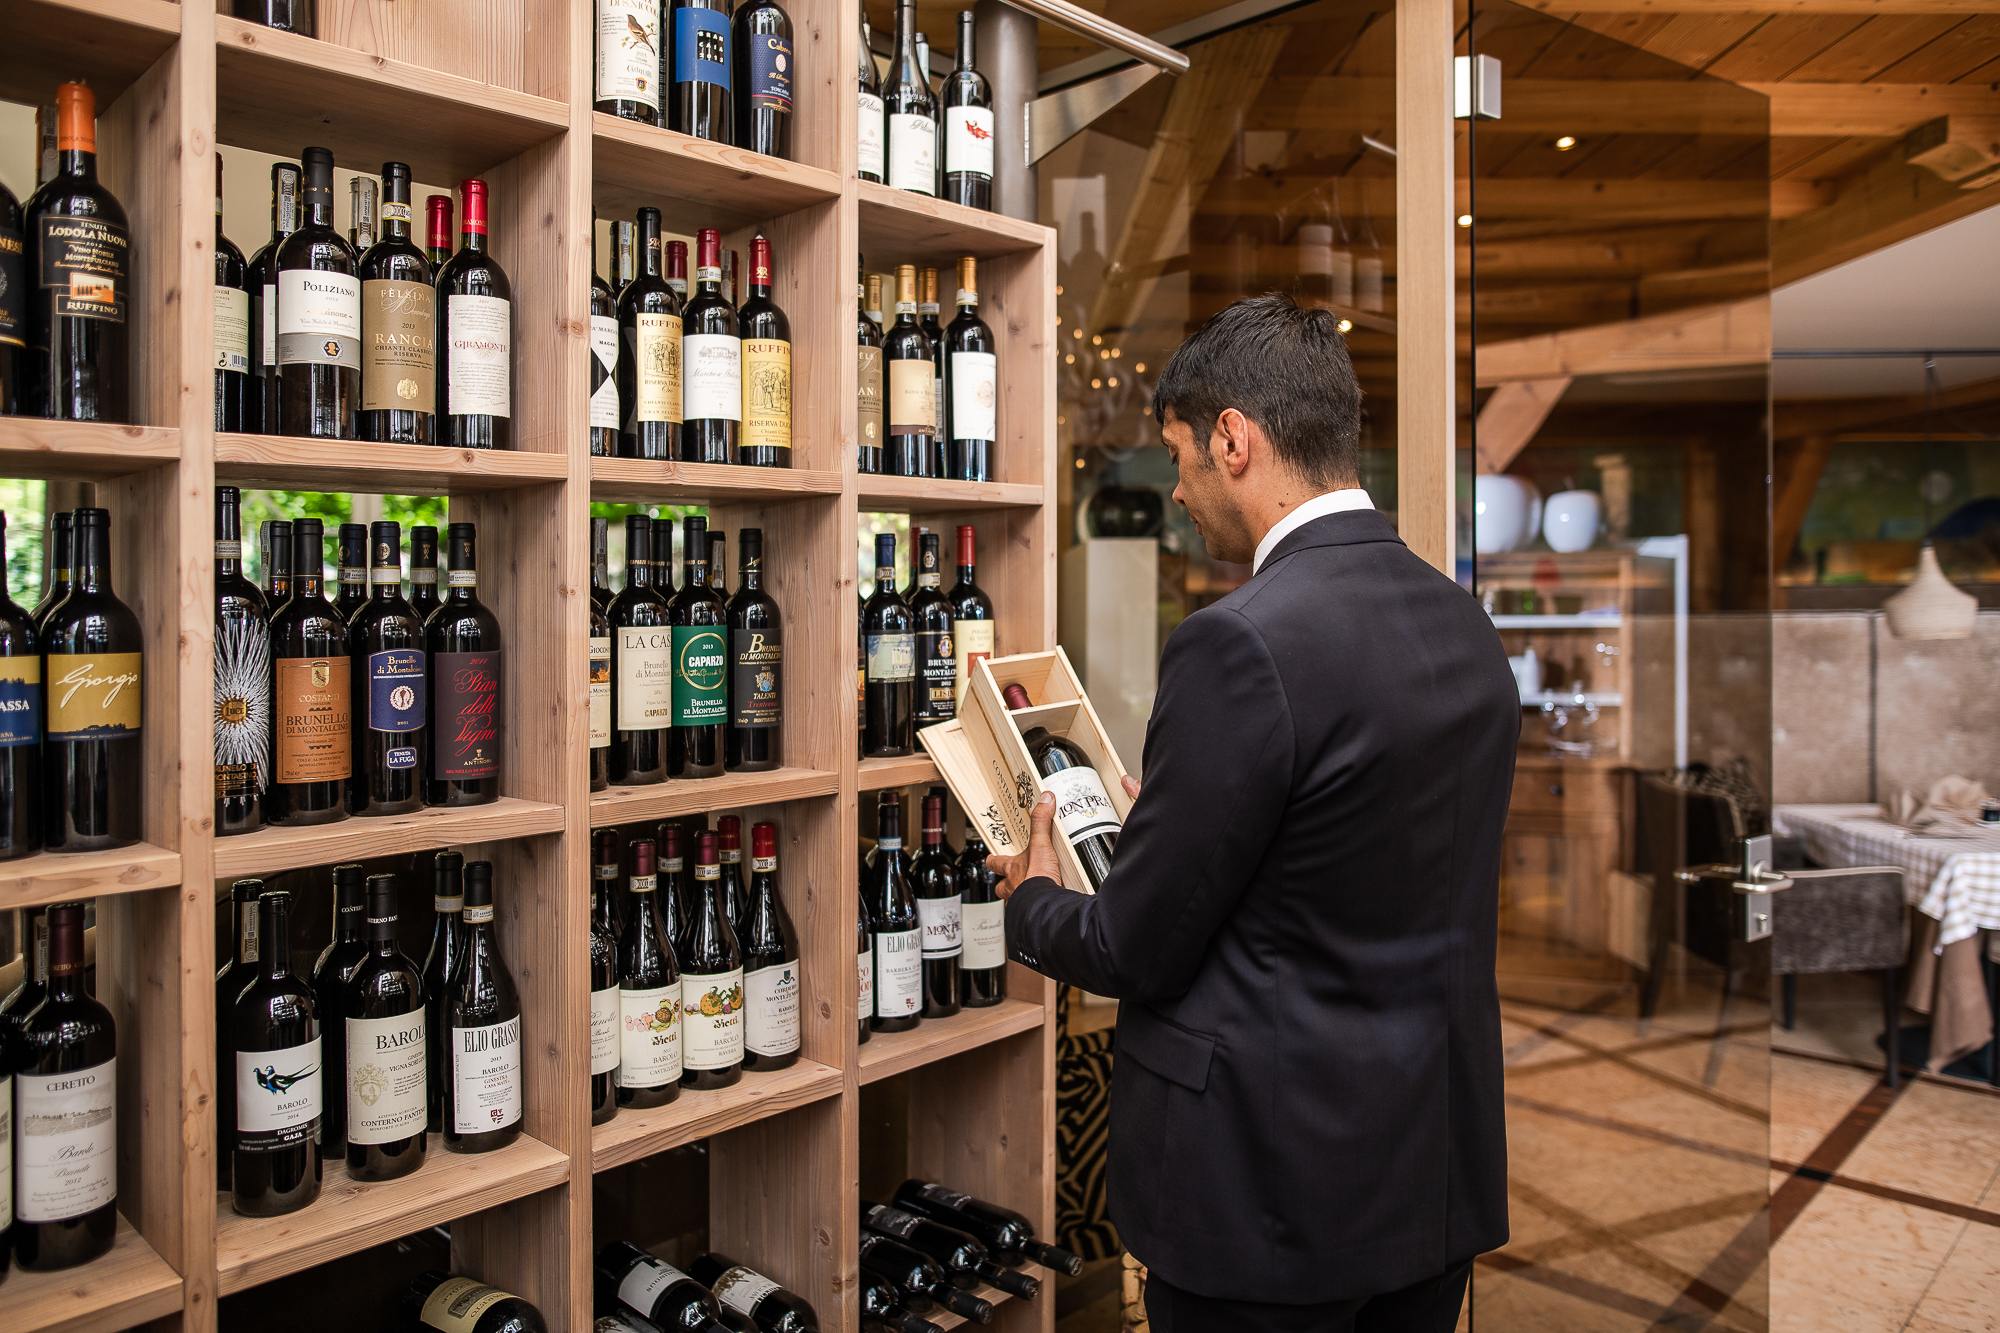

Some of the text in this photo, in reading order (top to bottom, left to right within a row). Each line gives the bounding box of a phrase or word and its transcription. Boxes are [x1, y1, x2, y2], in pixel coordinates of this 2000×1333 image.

[80, 221, 108, 231] TENUTA
[48, 225, 128, 249] LODOLA NUOVA
[303, 280, 355, 298] POLIZIANO
[380, 287, 431, 304] FÈLSINA
[66, 301, 118, 315] RUFFINO
[402, 322, 416, 330] 2013
[641, 319, 683, 332] RUFFINO
[375, 333, 434, 350] RANCIA
[454, 340, 508, 353] GIRAMONTE
[393, 351, 422, 359] RISERVA
[644, 379, 668, 387] RISERVA
[749, 419, 778, 428] RISERVA
[625, 635, 646, 650] LA
[388, 656, 416, 665] Brunello
[688, 655, 724, 668] CAPARZO
[377, 665, 422, 674] di Montalcino
[636, 670, 643, 678] di
[55, 663, 138, 709] Giorgio
[298, 693, 340, 703] COSTANTI
[753, 692, 776, 700] TALENTI
[457, 694, 496, 715] delle
[691, 699, 723, 707] BRUNELLO
[286, 713, 348, 726] BRUNELLO
[645, 708, 668, 718] CAPARZO
[297, 723, 348, 734] MONTALCINO
[399, 756, 415, 764] FUGA
[992, 759, 1020, 817] CONTERNO
[887, 936, 905, 954] ELIO
[713, 1016, 738, 1029] Vietti
[464, 1020, 519, 1053] ELIO GRASSO
[651, 1031, 677, 1046] Vietti
[714, 1034, 739, 1046] BAROLO
[653, 1051, 678, 1064] BAROLO
[389, 1063, 408, 1073] VIGNA
[482, 1063, 509, 1075] BAROLO
[46, 1074, 96, 1092] CERETTO
[277, 1097, 308, 1111] BAROLO
[287, 1113, 299, 1121] 2014
[361, 1116, 403, 1127] CONTERNO
[277, 1123, 308, 1136] DAGROMIS
[284, 1131, 303, 1141] GAJA
[48, 1142, 95, 1161] Barolo
[64, 1176, 82, 1187] 2012
